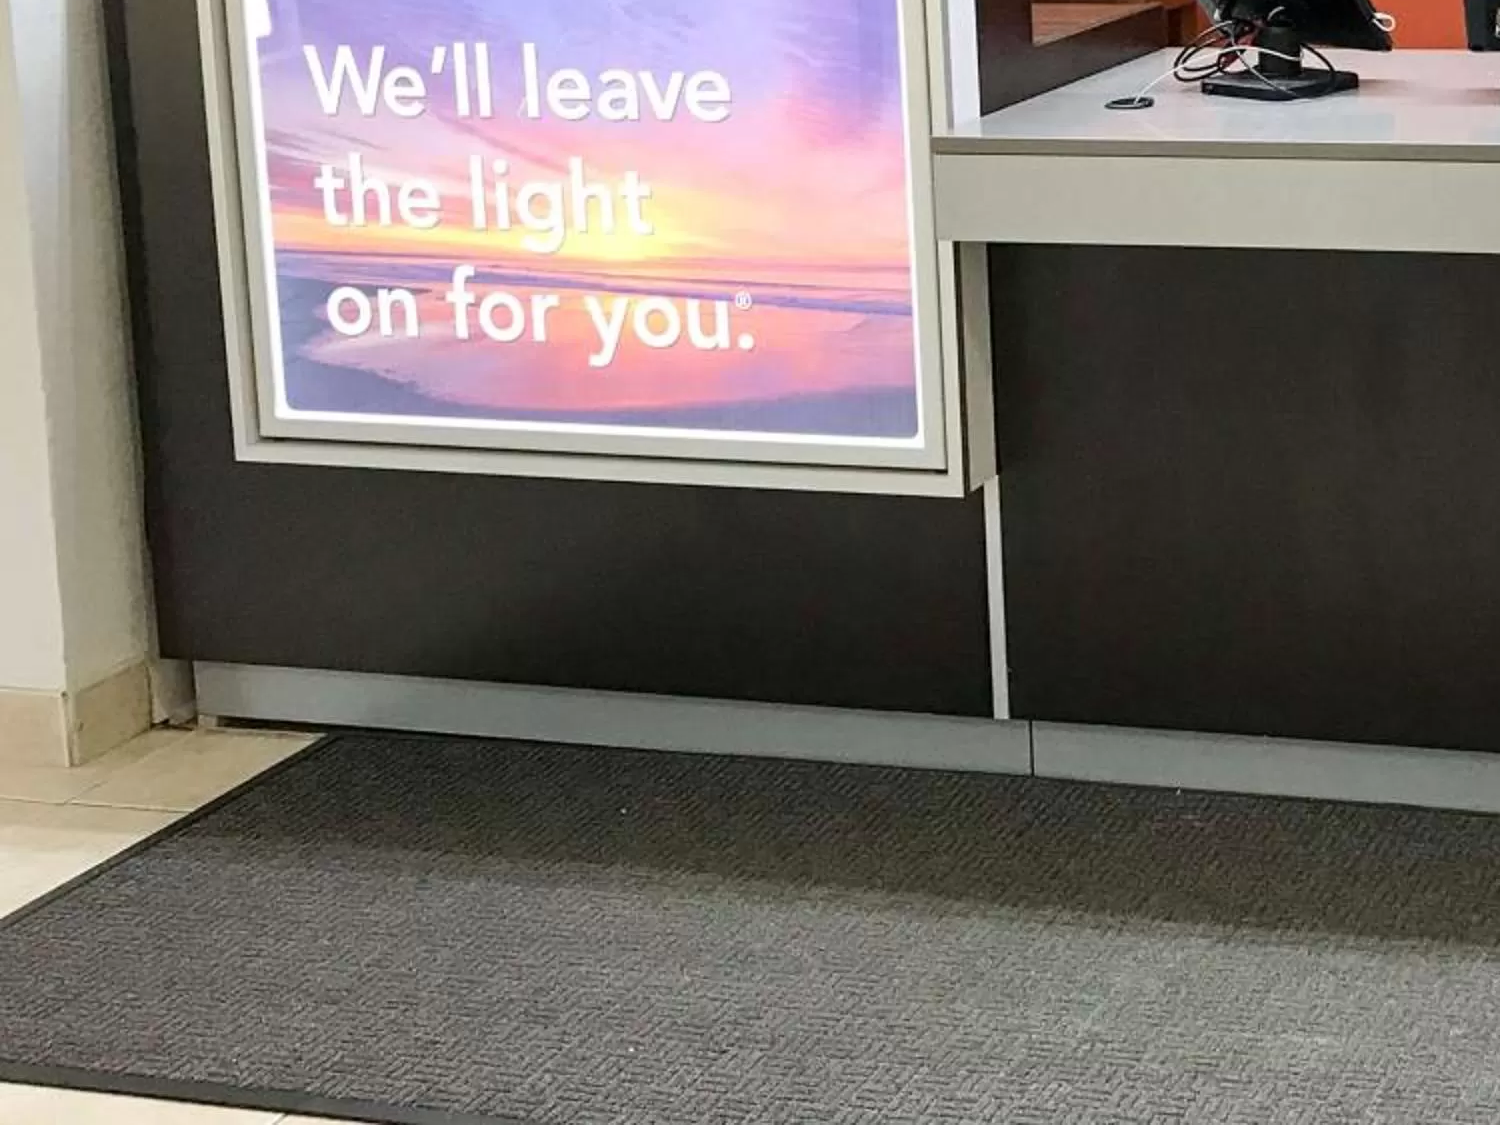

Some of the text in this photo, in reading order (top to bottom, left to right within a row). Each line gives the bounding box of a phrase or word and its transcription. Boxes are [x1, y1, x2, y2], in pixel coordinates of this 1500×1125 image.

[303, 41, 732, 123] We'll leave
[315, 153, 654, 256] the light
[326, 284, 419, 338] on
[446, 265, 559, 342] for
